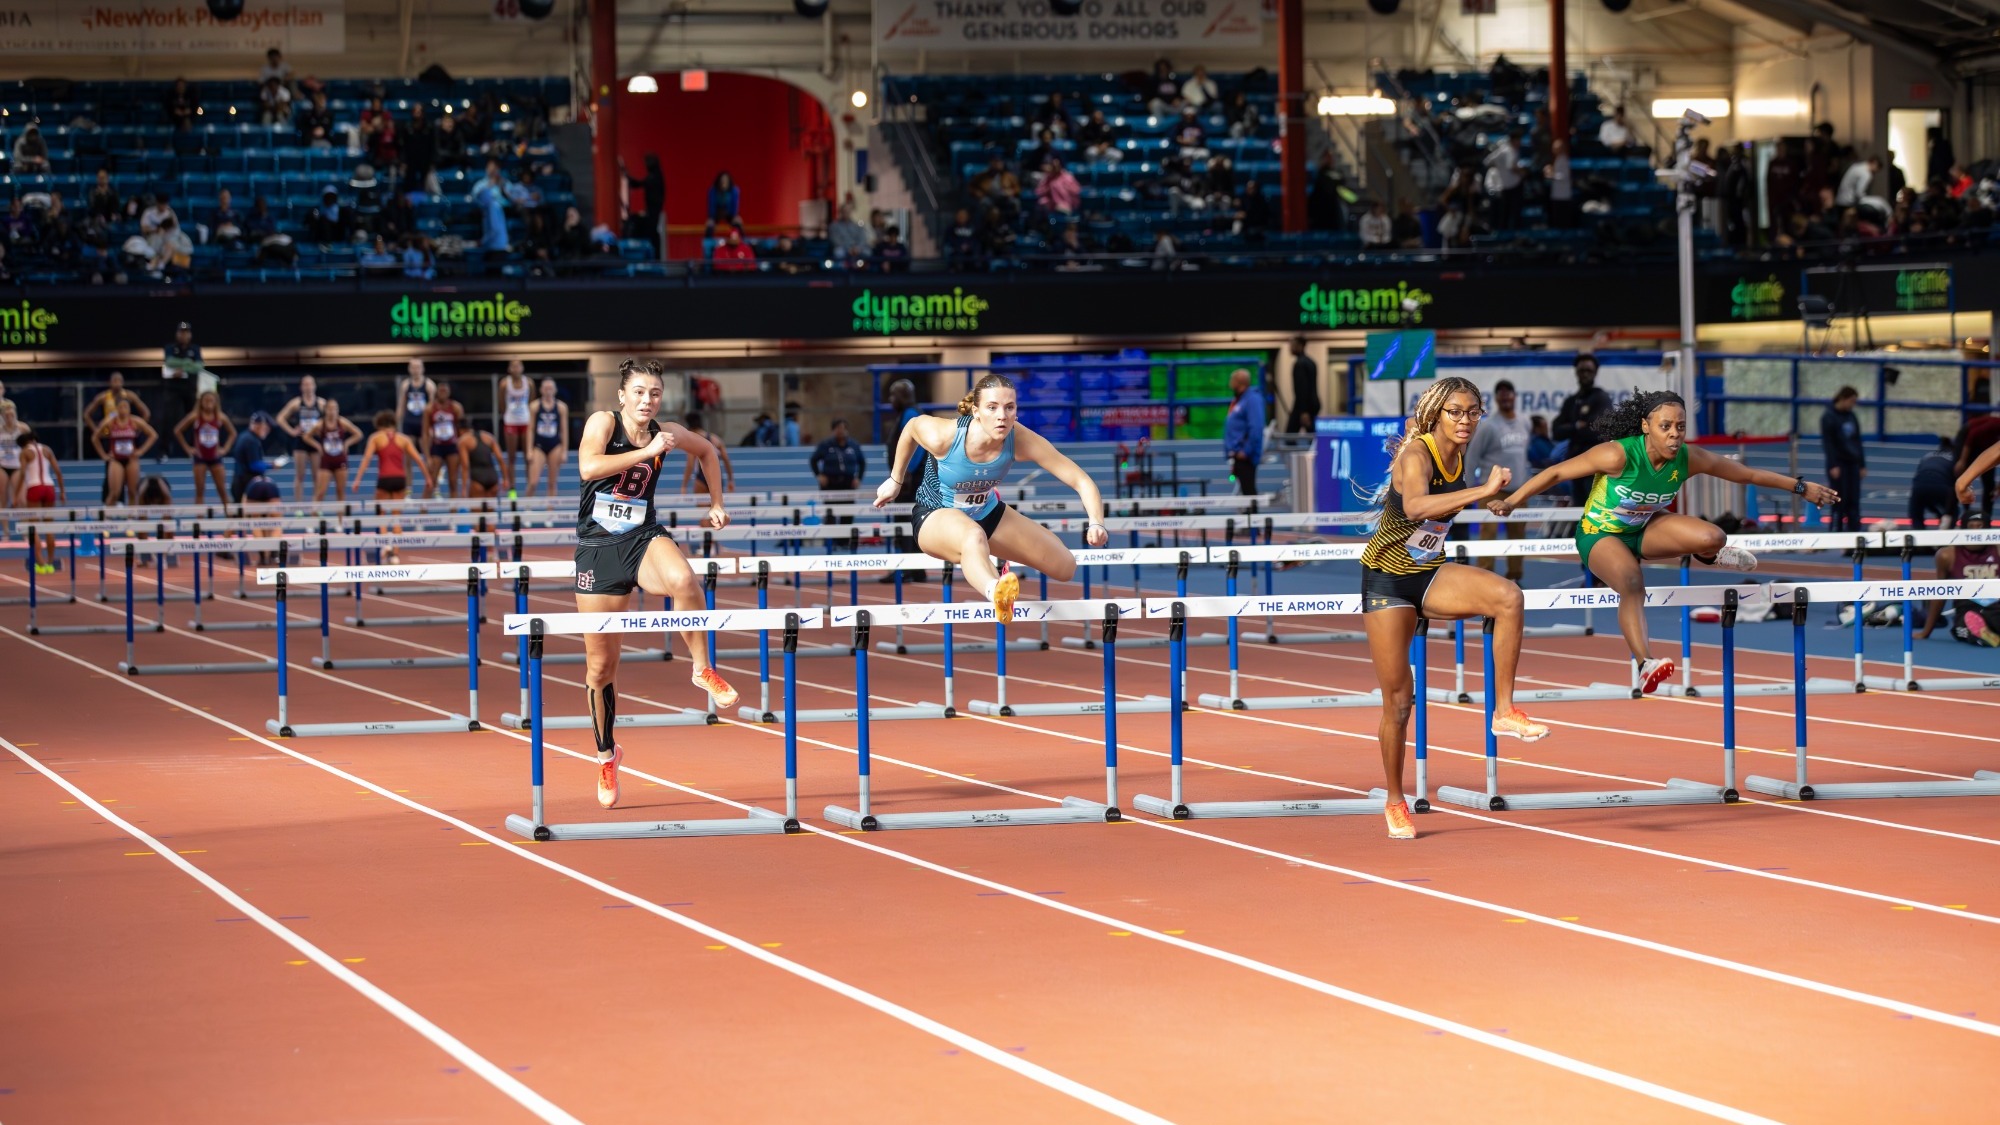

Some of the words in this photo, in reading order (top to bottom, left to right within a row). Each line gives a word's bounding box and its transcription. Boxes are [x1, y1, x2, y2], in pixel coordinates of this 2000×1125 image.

[934, 1, 1005, 18] THANK
[1113, 1, 1149, 18] ALL
[1160, 1, 1206, 18] OUR
[962, 23, 1078, 41] GENEROUS
[1089, 21, 1179, 40] DONORS
[852, 286, 980, 335] dynamic
[390, 292, 520, 342] dynamic
[852, 316, 979, 332] PRODUCTIONS
[391, 323, 522, 338] PRODUCTIONS
[607, 503, 633, 521] 154
[756, 529, 773, 539] THE
[775, 528, 807, 538] ARMORY
[1965, 534, 1983, 542] THE
[1744, 538, 1760, 548] THE
[1762, 537, 1804, 548] ARMORY
[1292, 548, 1311, 558] THE
[1314, 547, 1355, 558] ARMORY
[1519, 545, 1537, 556] THE
[824, 559, 843, 569] THE
[846, 559, 888, 569] ARMORY
[344, 570, 363, 580] THE
[367, 568, 411, 579] ARMORY
[1879, 587, 1905, 597] THE
[1908, 585, 1963, 597] ARMORY
[1570, 594, 1594, 605] THE
[1258, 602, 1283, 612] THE
[1287, 600, 1344, 612] ARMORY
[944, 609, 970, 620] THE
[620, 617, 646, 629] THE
[651, 615, 709, 629] ARMORY
